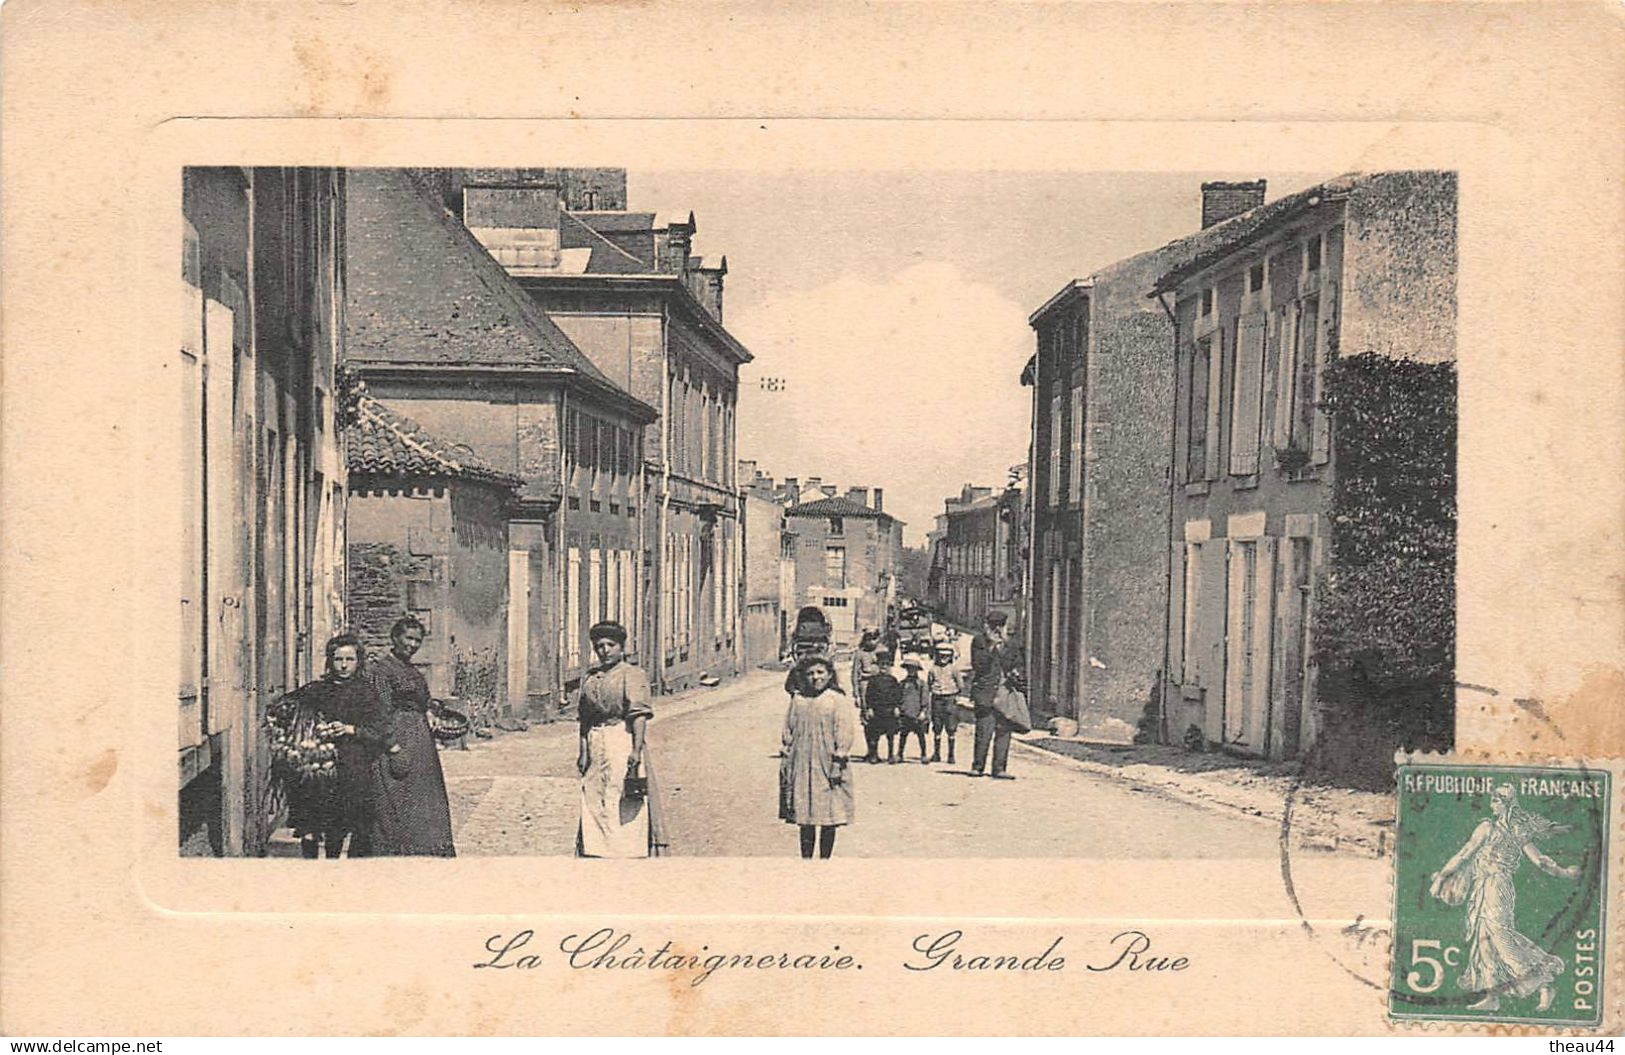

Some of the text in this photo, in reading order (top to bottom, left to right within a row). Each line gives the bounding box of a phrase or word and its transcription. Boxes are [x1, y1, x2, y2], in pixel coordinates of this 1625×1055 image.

[1520, 778, 1602, 800] FRANÇAISE
[473, 928, 1190, 987] La Châtaigneraie. Grande Rue
[1573, 928, 1596, 1010] POSTES
